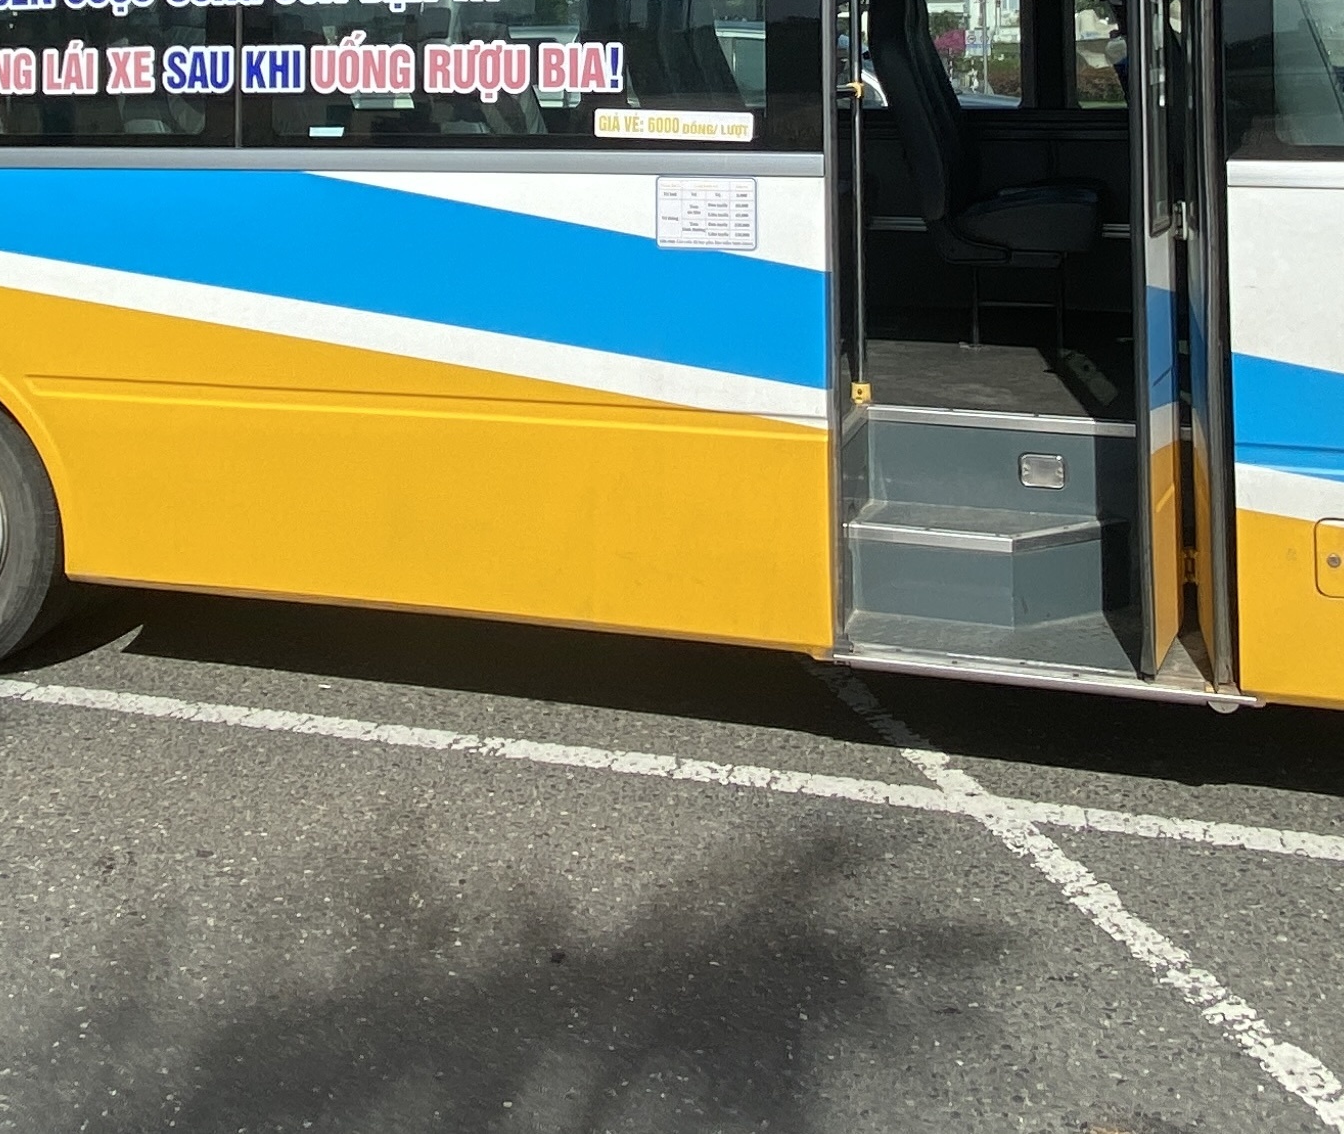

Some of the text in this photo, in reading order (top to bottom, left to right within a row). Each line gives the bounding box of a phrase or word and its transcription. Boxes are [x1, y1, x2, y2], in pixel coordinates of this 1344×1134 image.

[44, 41, 96, 92] LÁI
[109, 49, 154, 91] XE
[164, 48, 232, 91] SAU
[245, 49, 302, 91] KHI
[312, 32, 413, 92] UỐNG
[427, 45, 529, 101] RƯỢU
[541, 45, 623, 92] BIA!
[647, 116, 680, 134] 6000
